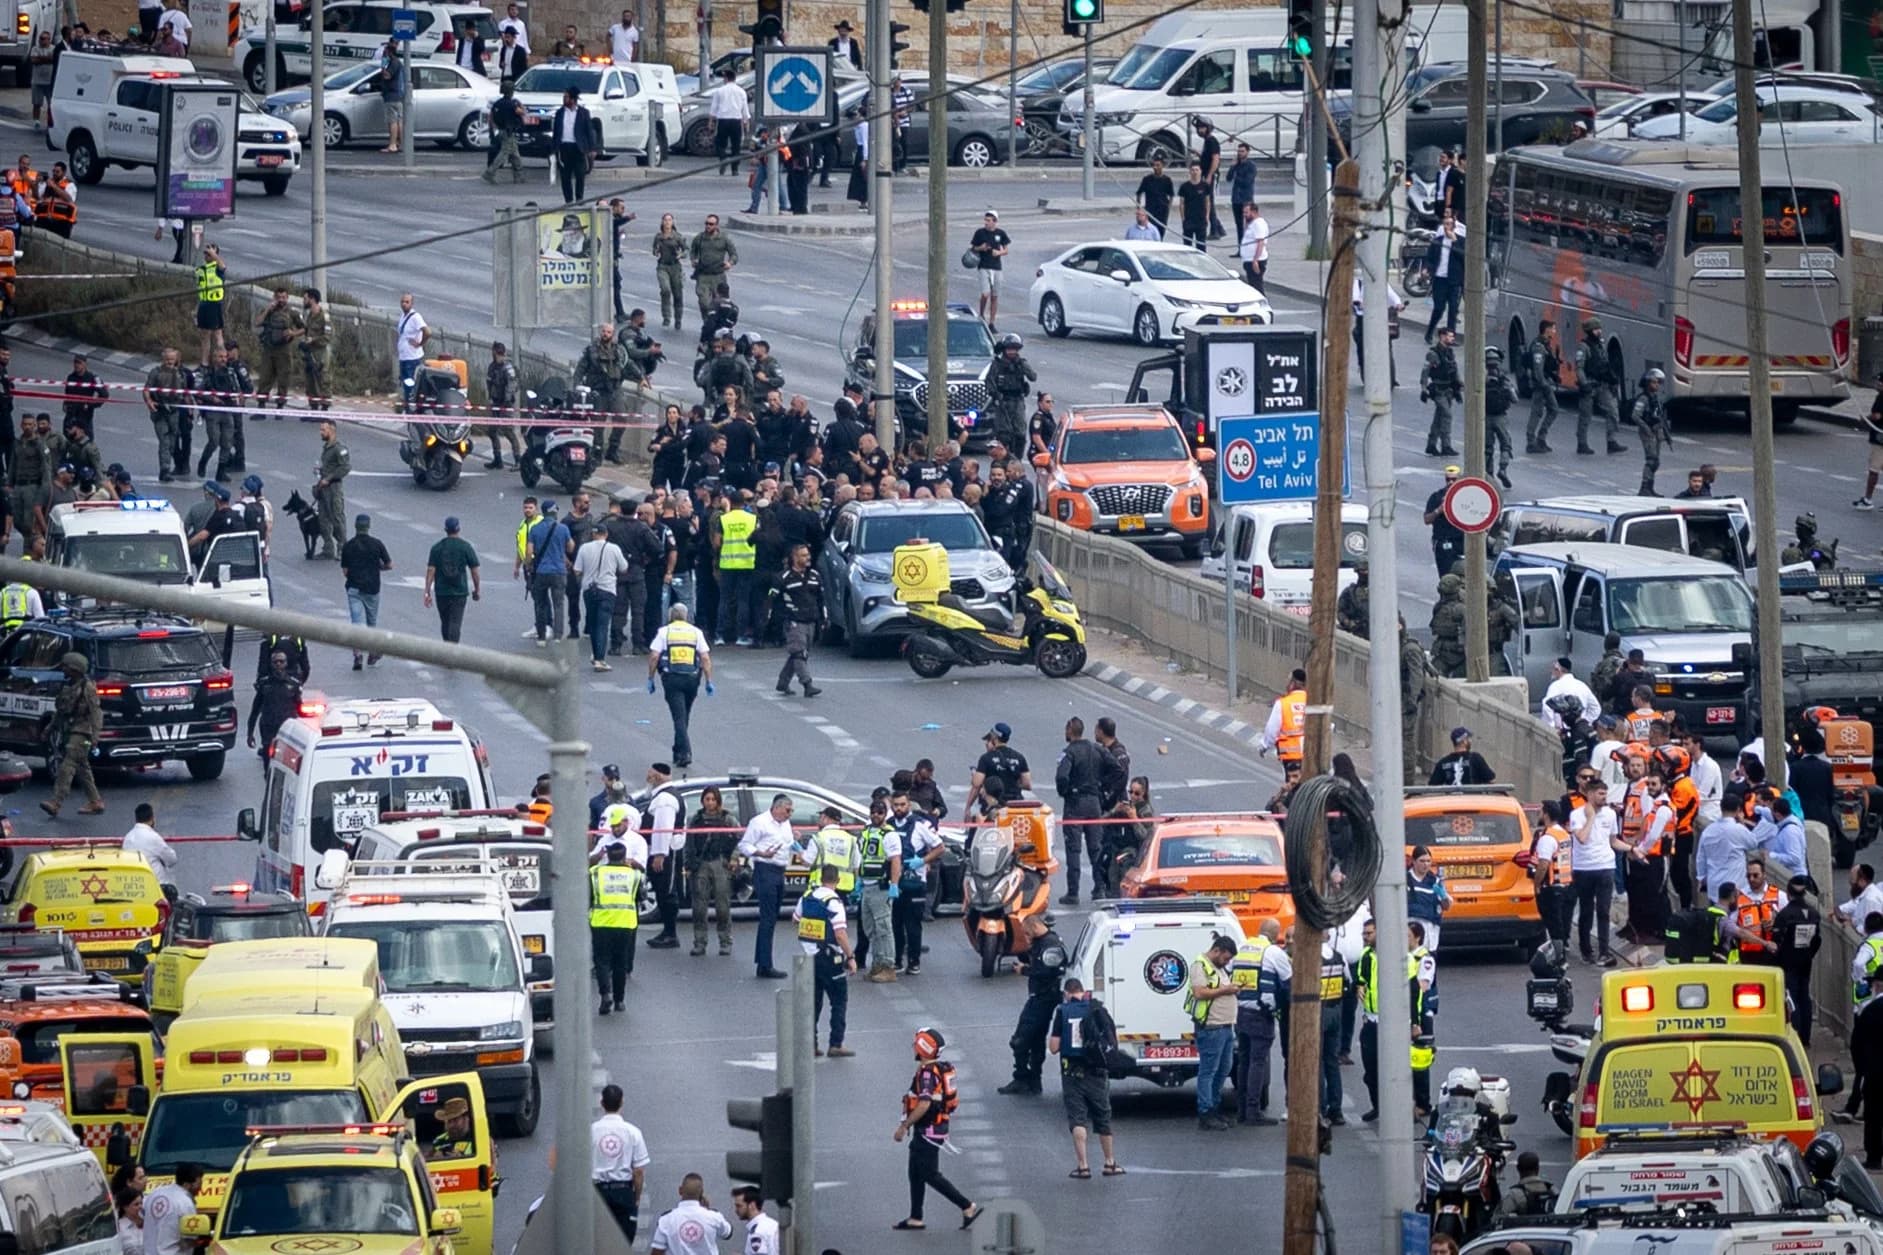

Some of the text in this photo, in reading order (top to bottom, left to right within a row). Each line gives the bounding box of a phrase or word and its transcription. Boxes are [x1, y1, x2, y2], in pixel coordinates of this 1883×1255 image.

[542, 261, 576, 272] המלך
[1272, 374, 1298, 393] לב
[1265, 396, 1303, 408] הבירה
[1254, 423, 1313, 444] תל אביב
[1231, 453, 1250, 467] 4.8
[1263, 446, 1306, 469] تل أبيب
[1257, 473, 1313, 489] Tel Aviv
[784, 876, 807, 885] LICE
[1656, 1017, 1727, 1032] פראמדיק
[1613, 1068, 1653, 1080] MAGEN
[1731, 1065, 1777, 1078] מגן דוד
[222, 1071, 292, 1086] פראמדיק
[1613, 1079, 1648, 1089] DAVID
[1745, 1079, 1778, 1091] אדום
[1613, 1088, 1649, 1099] ADOM
[1726, 1092, 1778, 1105] בישראל
[1614, 1097, 1665, 1109] IN ISRAEL
[1661, 1171, 1686, 1179] שמור
[1620, 1182, 1700, 1192] משמר הגבול
